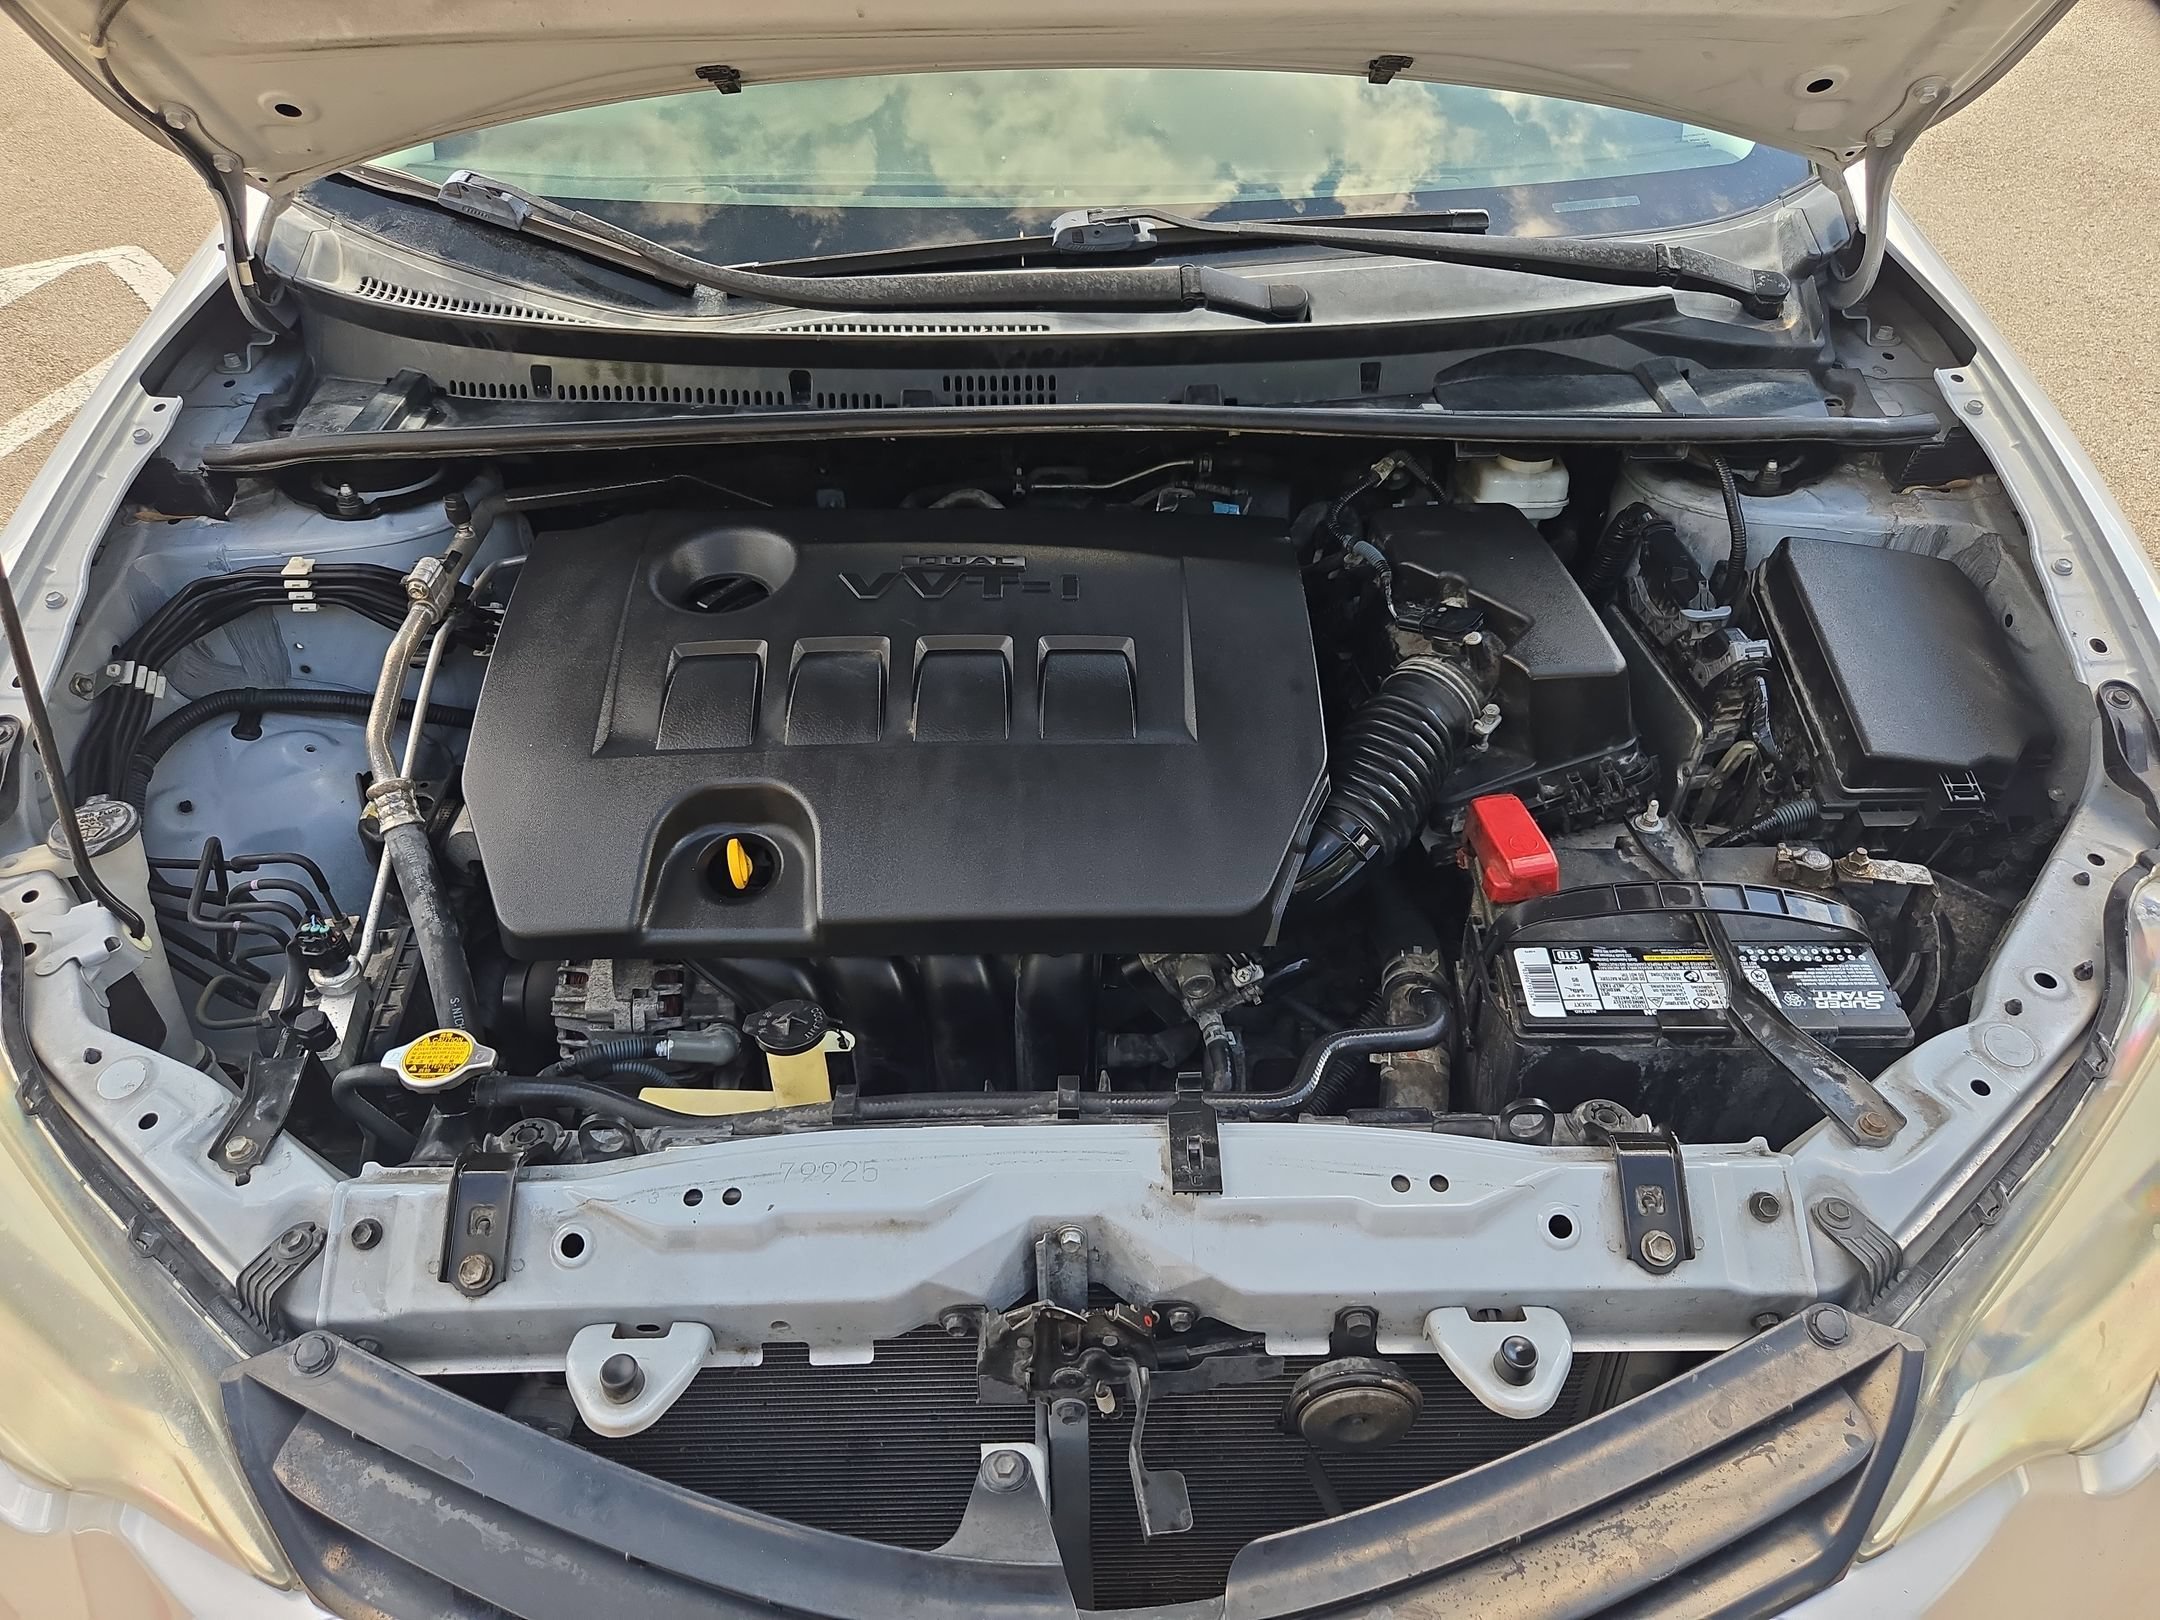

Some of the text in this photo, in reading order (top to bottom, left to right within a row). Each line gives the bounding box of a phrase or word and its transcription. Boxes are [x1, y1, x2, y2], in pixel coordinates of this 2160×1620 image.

[918, 555, 1016, 567] DUAL
[1557, 951, 1579, 959] STD
[1812, 991, 1885, 1001] START
[1815, 1000, 1881, 1009] SUPER
[780, 1161, 879, 1183] 79925
